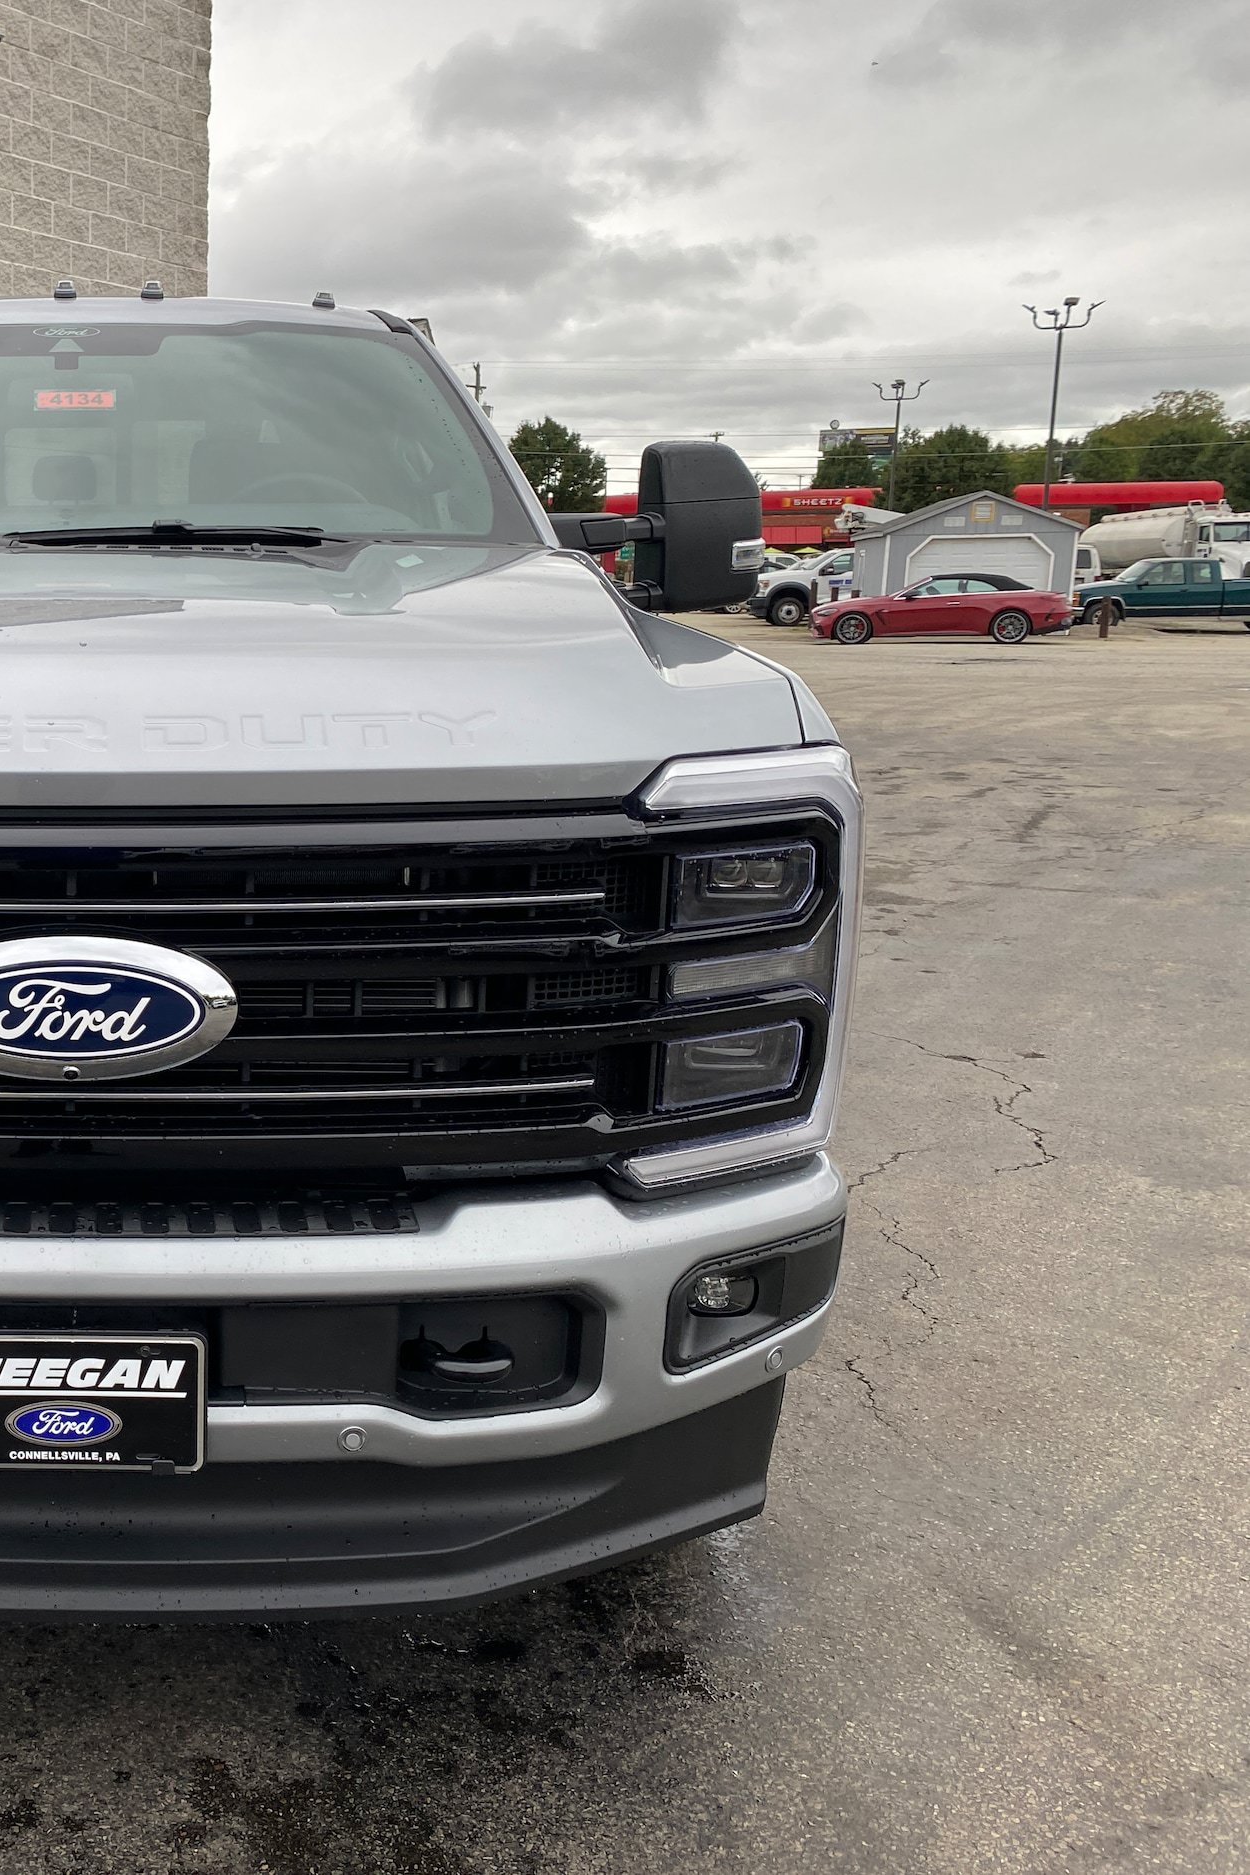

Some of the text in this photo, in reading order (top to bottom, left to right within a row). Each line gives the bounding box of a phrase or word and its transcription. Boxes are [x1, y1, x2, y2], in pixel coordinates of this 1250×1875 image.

[45, 327, 88, 336] Ford
[50, 393, 103, 405] 4134
[793, 498, 843, 506] SHEETZ
[143, 710, 496, 751] DUTY
[31, 1409, 95, 1435] Ford
[9, 1450, 121, 1462] CONNELLSVILLE, PA
